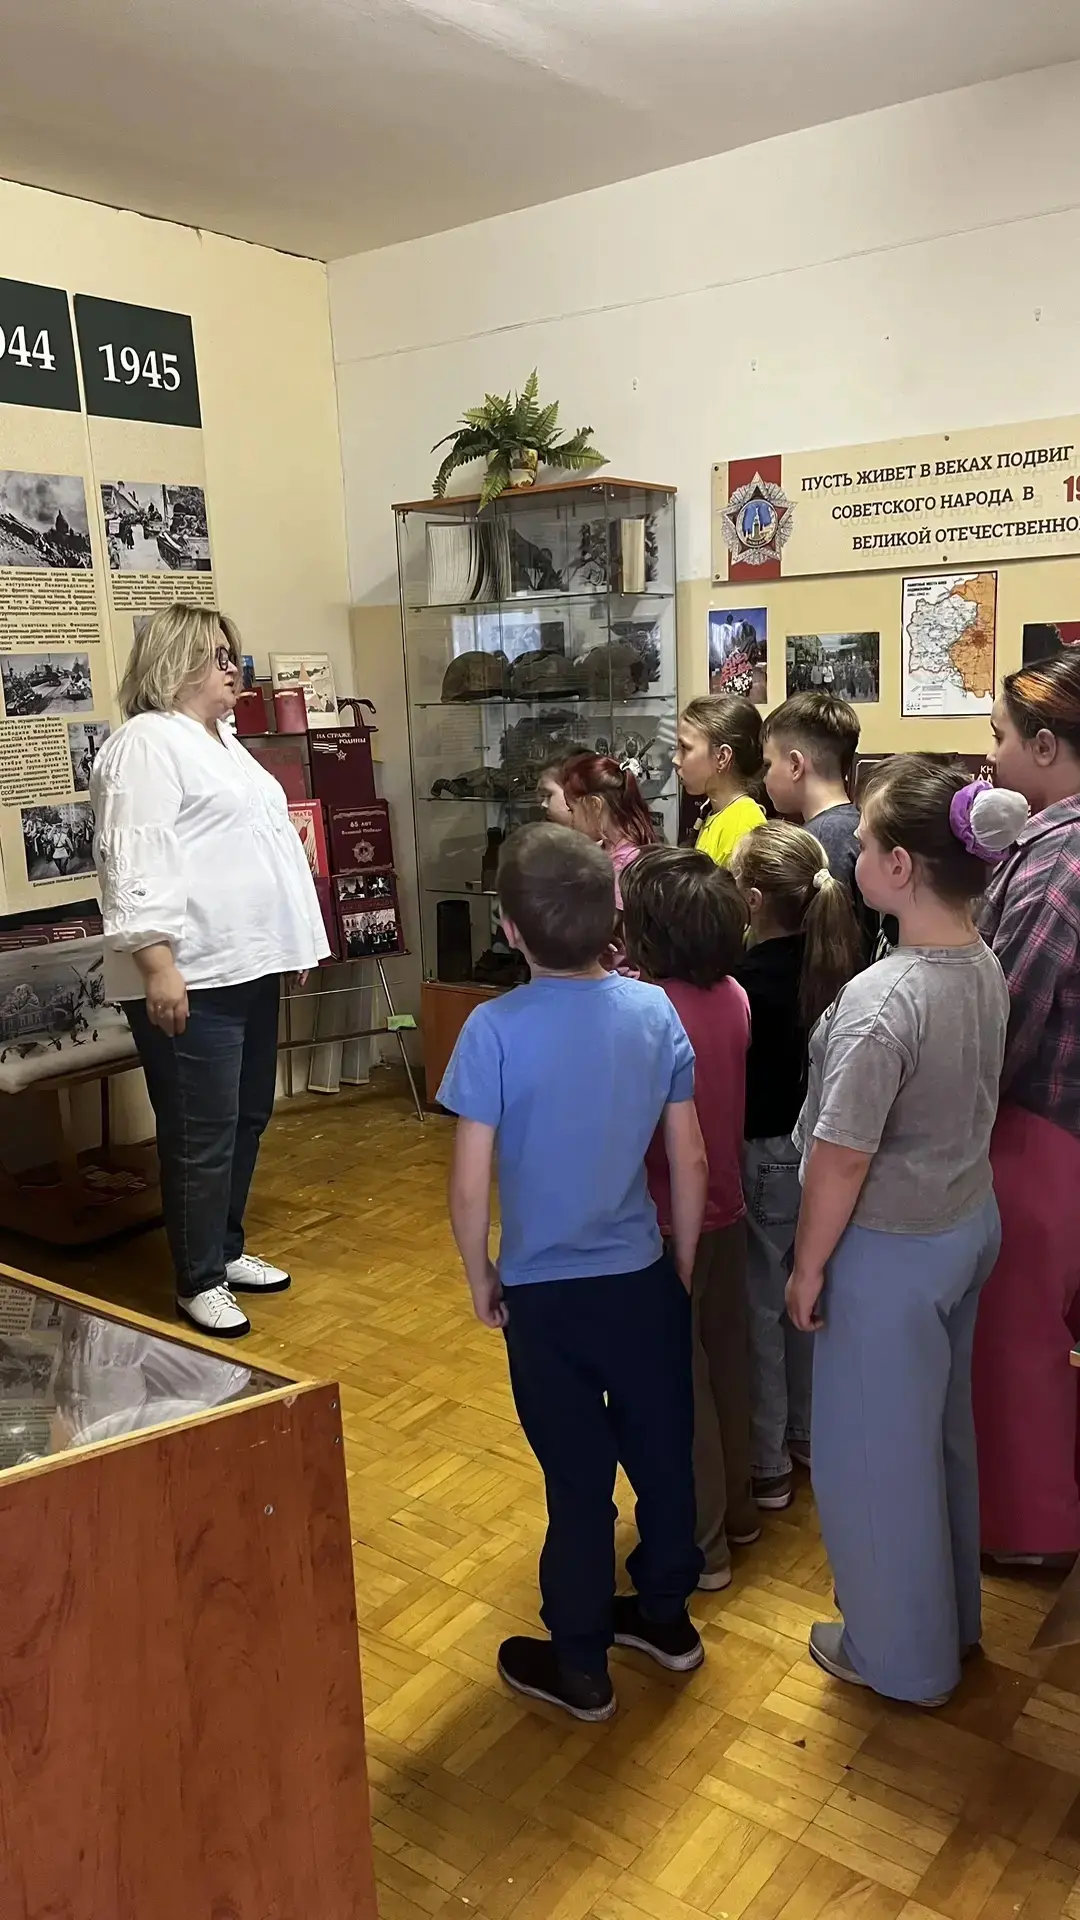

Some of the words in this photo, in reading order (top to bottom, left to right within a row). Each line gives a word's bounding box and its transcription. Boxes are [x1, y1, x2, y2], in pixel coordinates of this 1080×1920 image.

[0, 325, 56, 371] 44
[98, 343, 181, 391] 1945
[801, 473, 853, 491] ПУСТЬ
[857, 465, 916, 485] ЖИВЕТ
[920, 463, 931, 478] В
[935, 455, 992, 476] ВЕКАХ
[997, 445, 1074, 469] ПОДВИГ
[832, 496, 936, 520] СОВЕТСКОГО
[940, 488, 1013, 509] НАРОДА
[1022, 486, 1034, 501] В
[852, 526, 931, 550] ВЕЛИКОЙ
[935, 516, 1080, 543] ОТЕЧЕСТВЕННО
[980, 765, 994, 774] КН
